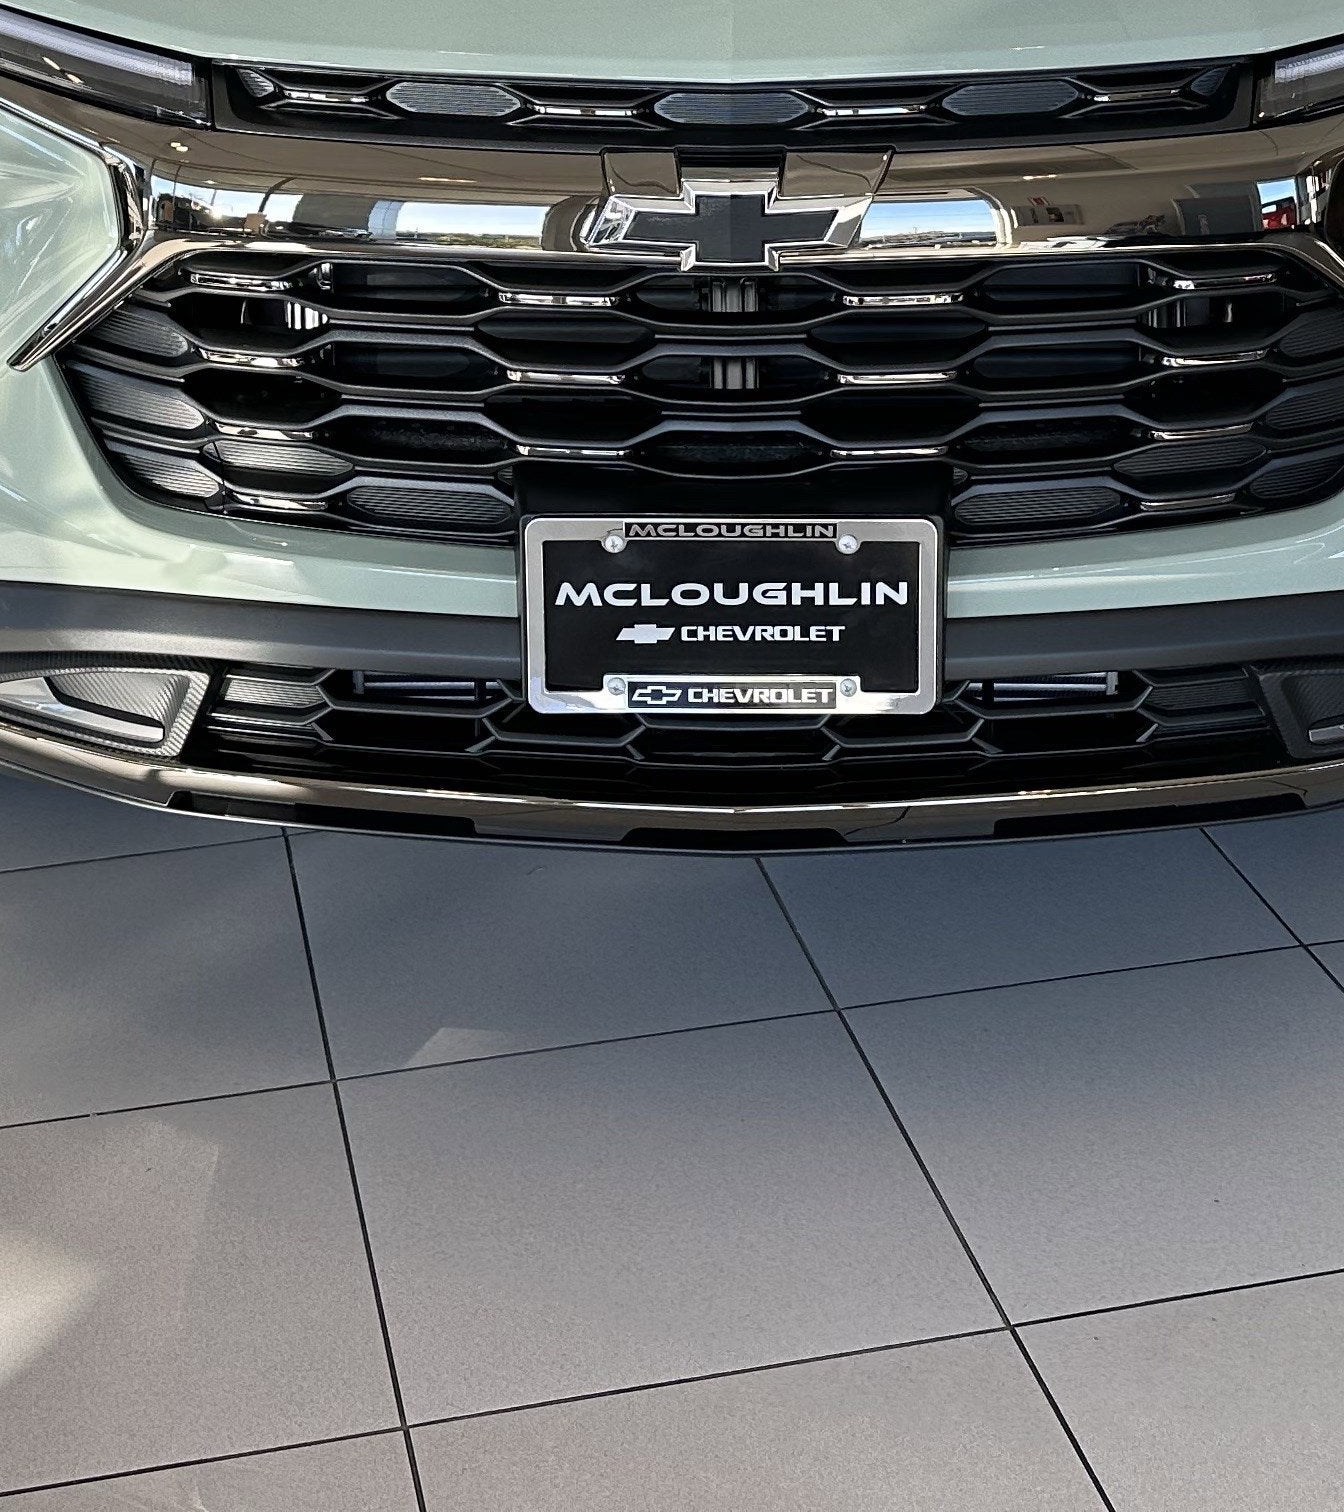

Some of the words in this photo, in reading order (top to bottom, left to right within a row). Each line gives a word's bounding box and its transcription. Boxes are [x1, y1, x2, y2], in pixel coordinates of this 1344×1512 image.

[628, 524, 834, 538] MCLOUGHLIN
[555, 582, 909, 606] MCLOUGHLIN
[680, 625, 846, 643] CHEVROLET
[687, 688, 834, 705] CHEVROLET
